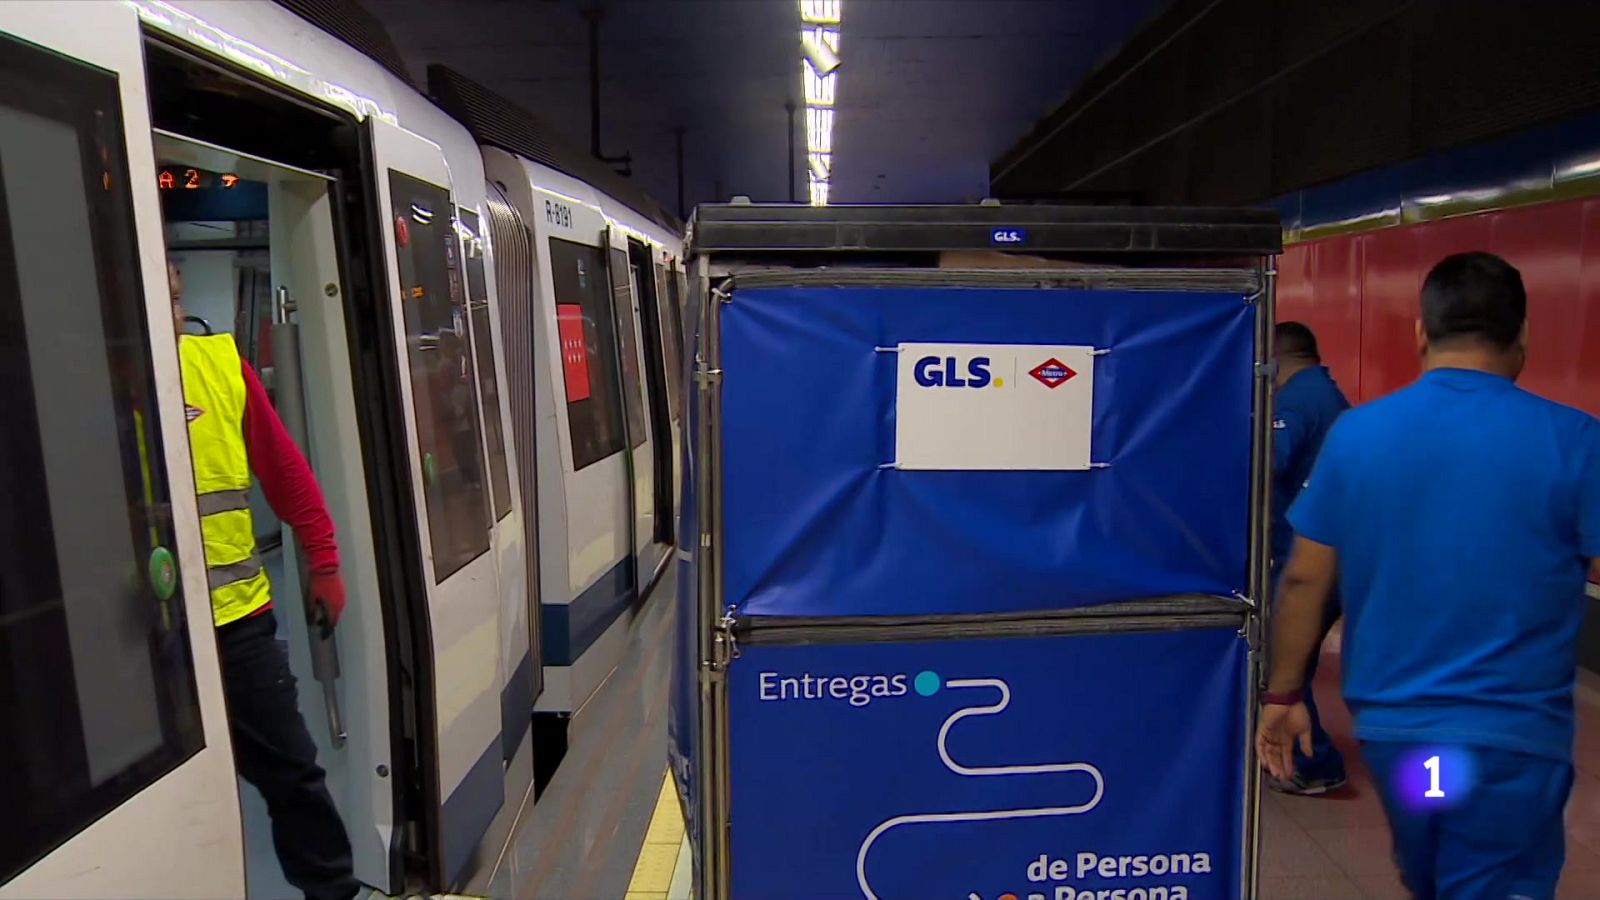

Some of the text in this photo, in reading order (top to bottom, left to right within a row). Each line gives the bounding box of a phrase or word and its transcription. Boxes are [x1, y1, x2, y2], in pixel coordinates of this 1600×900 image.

[184, 168, 200, 189] 2
[545, 200, 573, 229] R-8191
[759, 671, 908, 707] Entregas
[1027, 852, 1212, 882] de Persona
